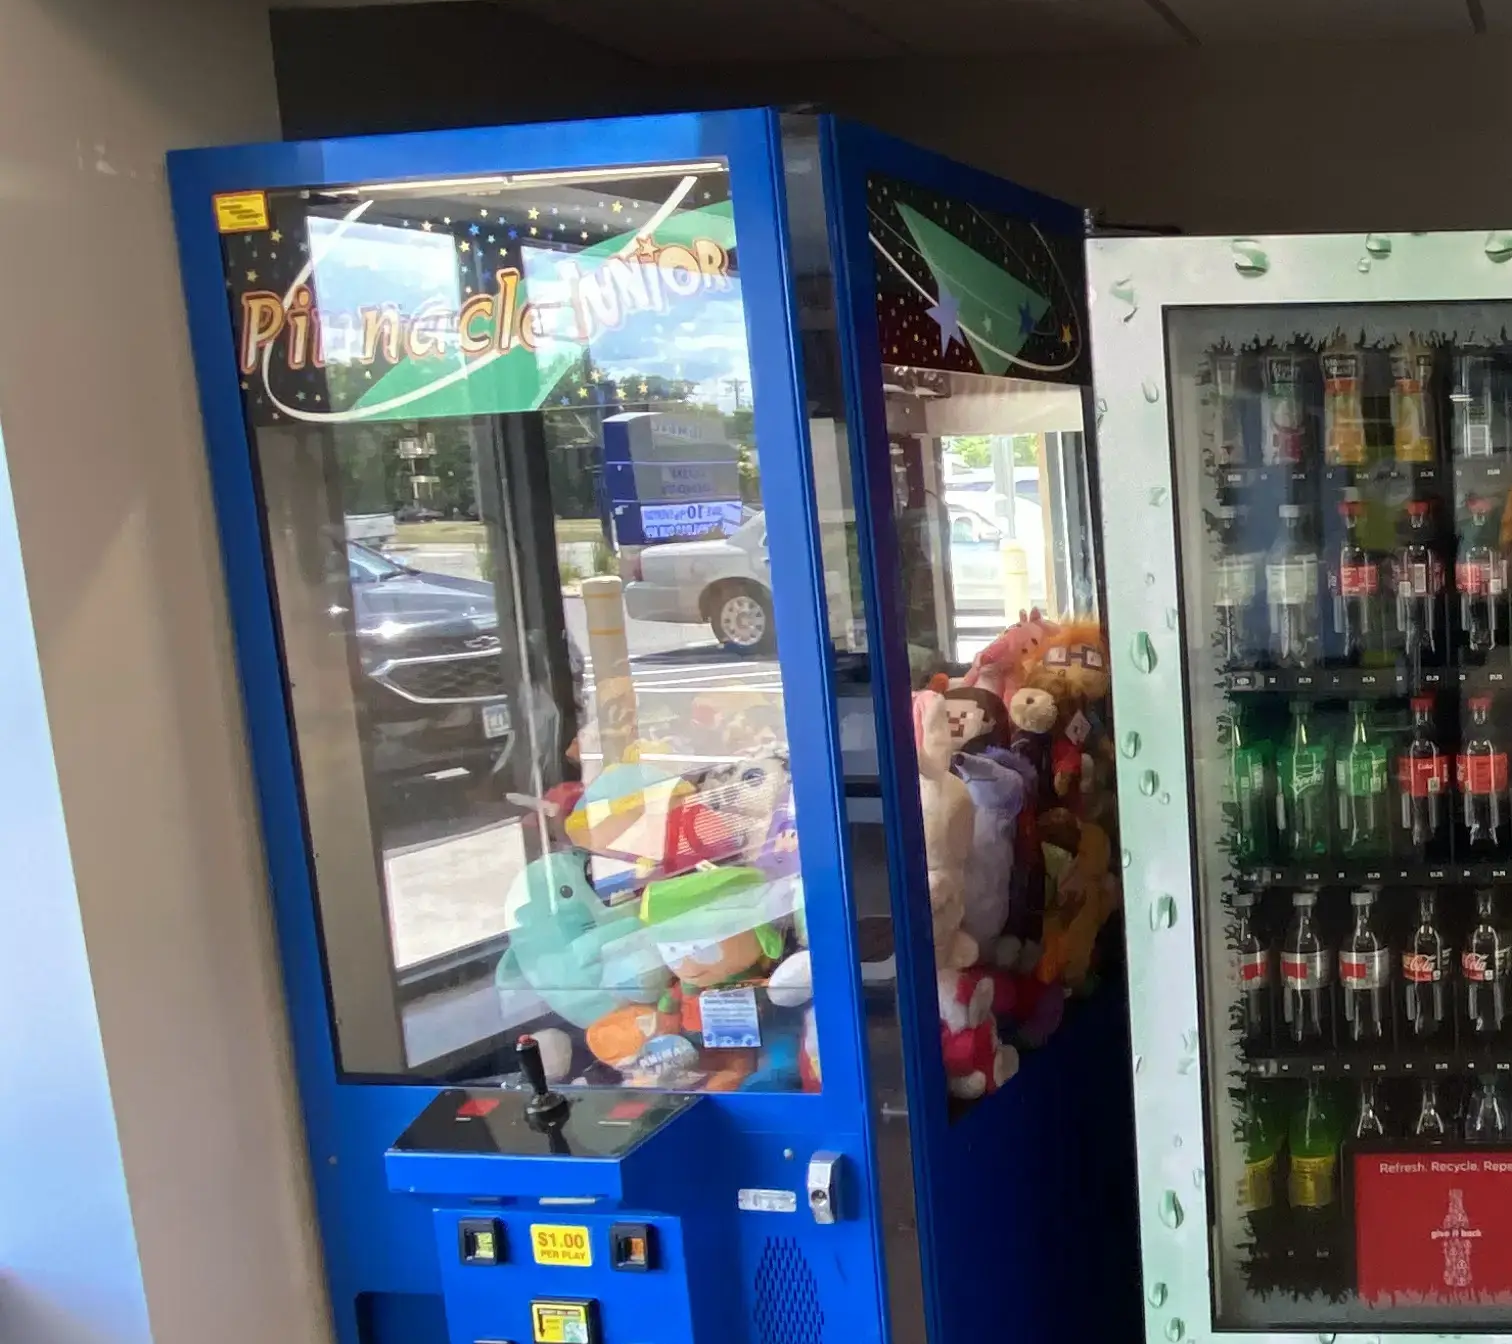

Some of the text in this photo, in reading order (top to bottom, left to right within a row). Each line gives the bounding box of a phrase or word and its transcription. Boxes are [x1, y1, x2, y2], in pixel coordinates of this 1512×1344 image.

[1379, 1161, 1427, 1174] Refresh.
[1431, 1161, 1479, 1173] Recycle.
[537, 1231, 584, 1250] $1.00
[540, 1249, 586, 1260] PER PLAY
